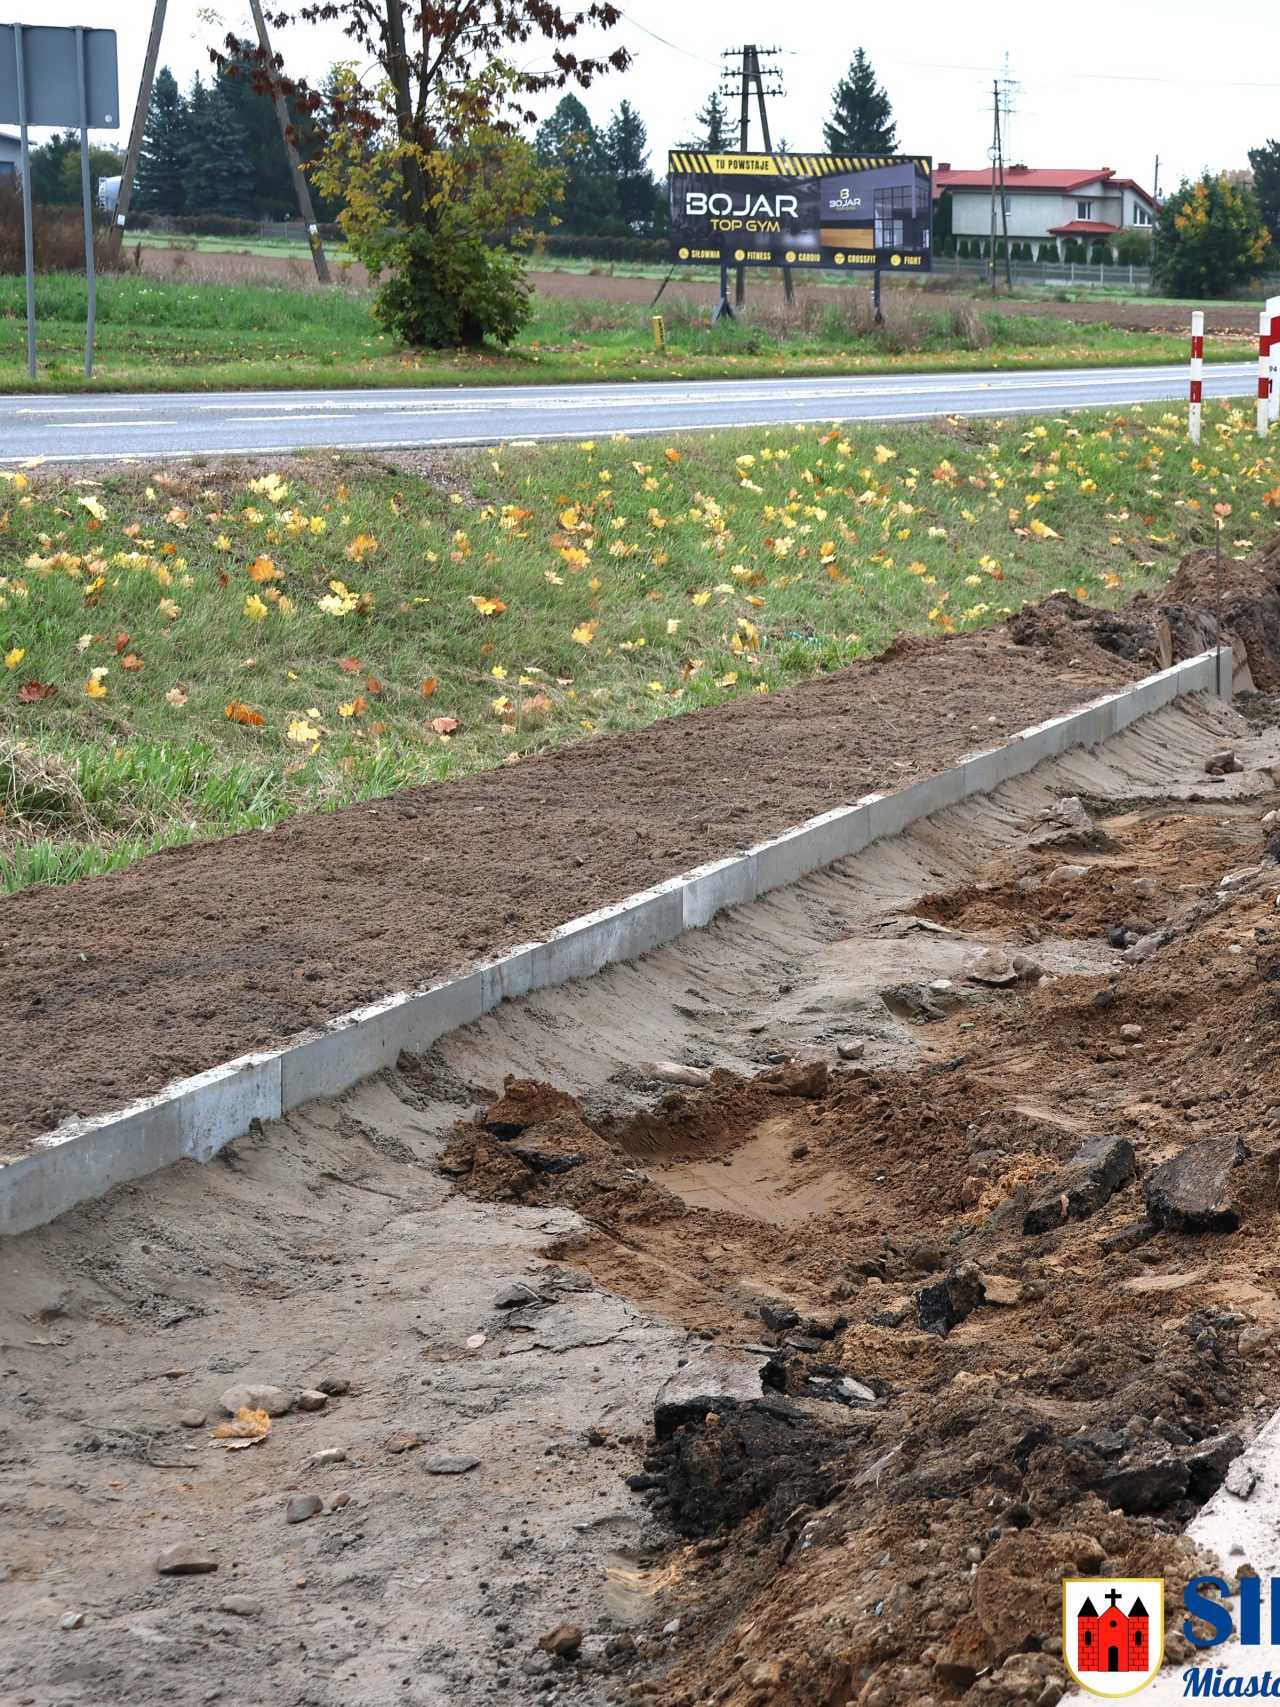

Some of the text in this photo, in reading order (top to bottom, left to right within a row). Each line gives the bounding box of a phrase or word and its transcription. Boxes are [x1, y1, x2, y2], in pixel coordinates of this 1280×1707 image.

[716, 159, 769, 170] TU POWSTAJE
[686, 192, 799, 218] BOJAR
[829, 198, 861, 208] BOJAR
[711, 219, 781, 233] TOP GYM
[691, 249, 922, 265] SIŁOWNIA FITNESS CARDIO CROSSFIT FIGHT
